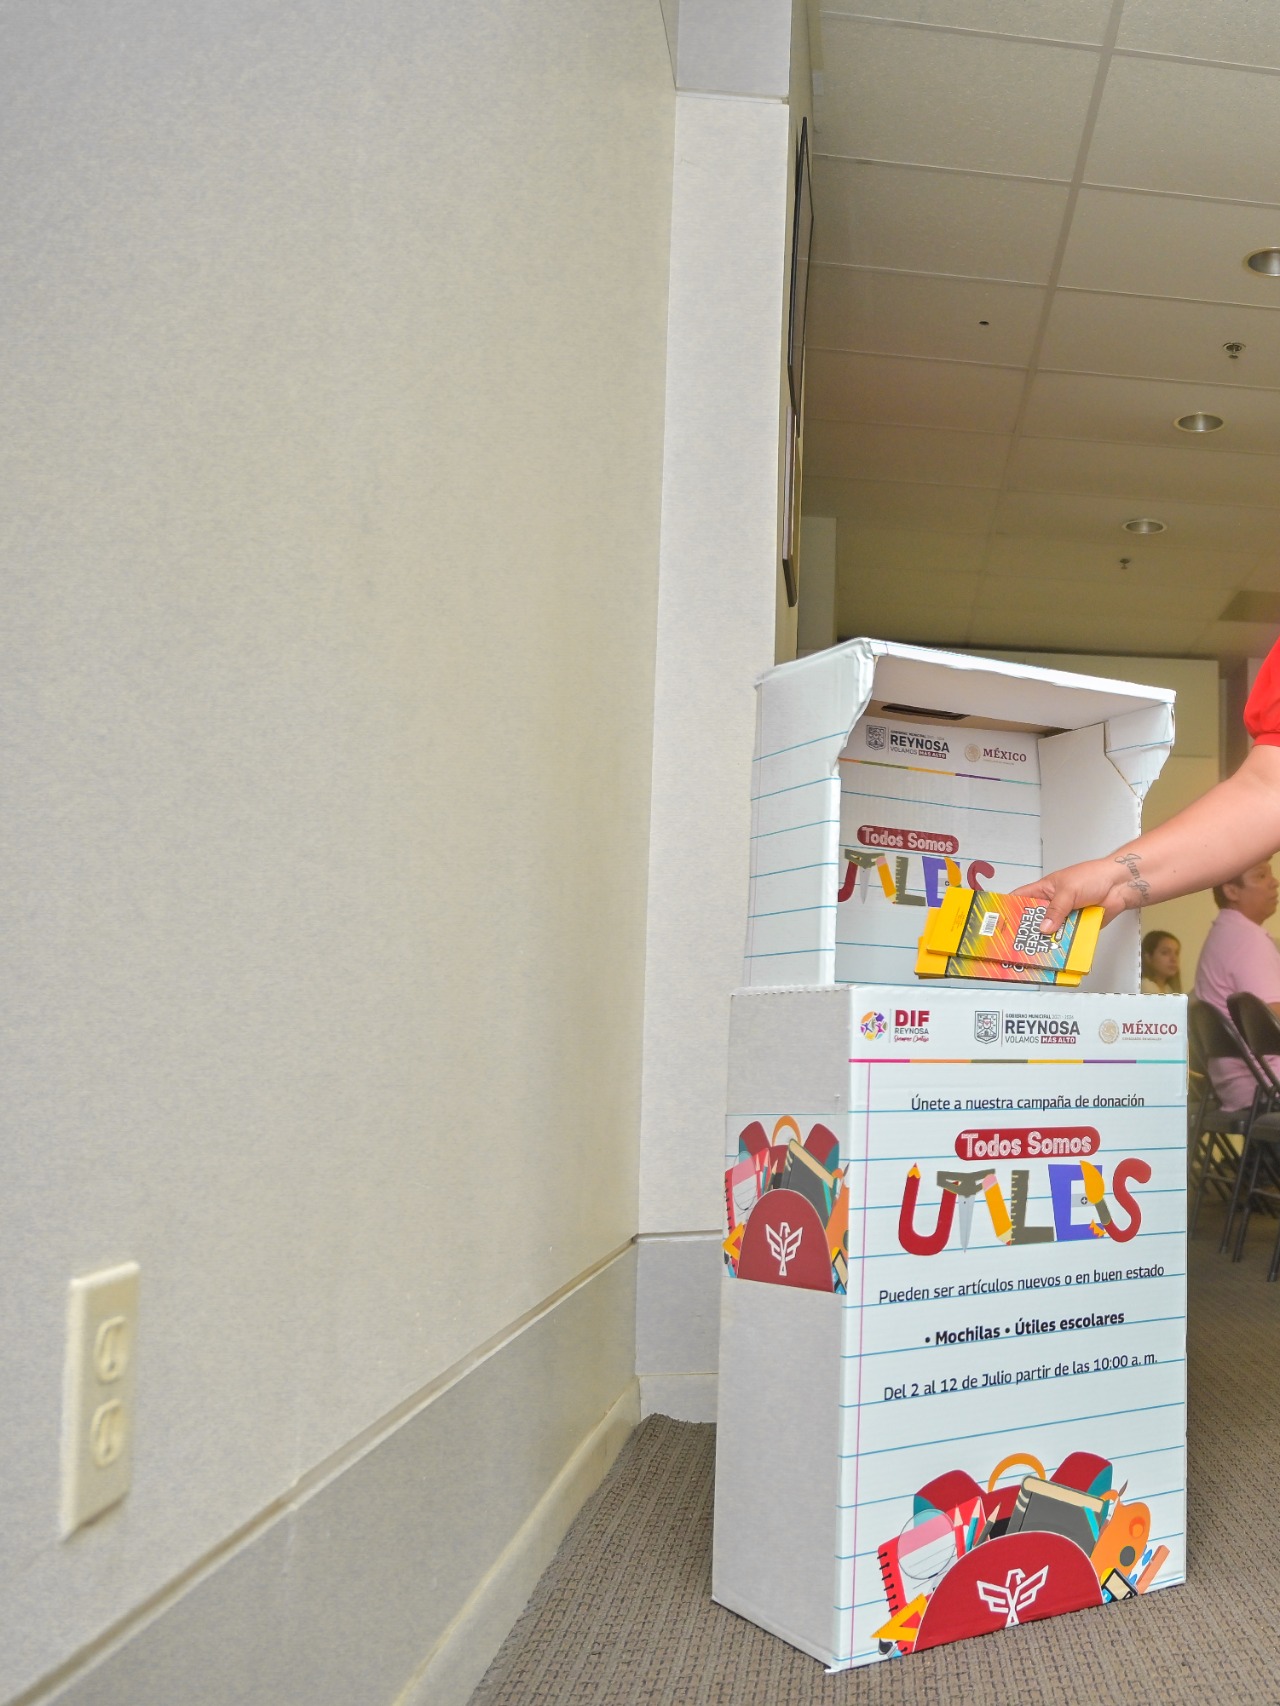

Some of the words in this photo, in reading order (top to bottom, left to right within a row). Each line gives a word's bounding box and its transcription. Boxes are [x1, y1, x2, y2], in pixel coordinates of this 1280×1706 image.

[890, 734, 950, 753] REYNOSA
[983, 747, 1027, 762] MÉXICO
[862, 826, 903, 846] Todos
[907, 832, 953, 853] Somos
[1014, 907, 1036, 951] PENCILS
[895, 1009, 930, 1027] DIF
[1122, 1020, 1178, 1035] MÉXICO
[894, 1027, 930, 1035] REYNOSA
[1005, 1020, 1081, 1036] REYNOSA
[1005, 1036, 1040, 1044] VOLAMOS
[1058, 1036, 1076, 1044] ALTO
[911, 1094, 951, 1110] Únete
[954, 1100, 961, 1110] a
[965, 1097, 1013, 1110] nuestra
[1017, 1096, 1071, 1111] campaña
[1075, 1095, 1089, 1108] de
[1093, 1093, 1145, 1107] donación
[961, 1132, 1022, 1158] Todos
[1027, 1131, 1092, 1155] Somos
[898, 1157, 1152, 1256] UTILES
[879, 1286, 930, 1304] Pueden
[933, 1285, 955, 1298] ser
[958, 1278, 1014, 1296] artículos
[1017, 1275, 1061, 1290] nuevos
[1064, 1274, 1072, 1285] o
[1075, 1272, 1090, 1284] en
[1093, 1269, 1122, 1282] buen
[1125, 1264, 1164, 1278] estado
[935, 1325, 1000, 1345] Mochilas
[1015, 1317, 1056, 1336] Útiles
[1059, 1312, 1125, 1330] escolares
[884, 1384, 906, 1401] Del
[911, 1383, 919, 1397] 2
[924, 1380, 936, 1395] al
[940, 1378, 957, 1393] 12
[961, 1375, 978, 1389] de
[982, 1370, 1012, 1387] Julio
[1015, 1364, 1051, 1385] partir
[1054, 1363, 1070, 1377] de
[1072, 1361, 1090, 1374] las
[1093, 1355, 1128, 1372] 10:00
